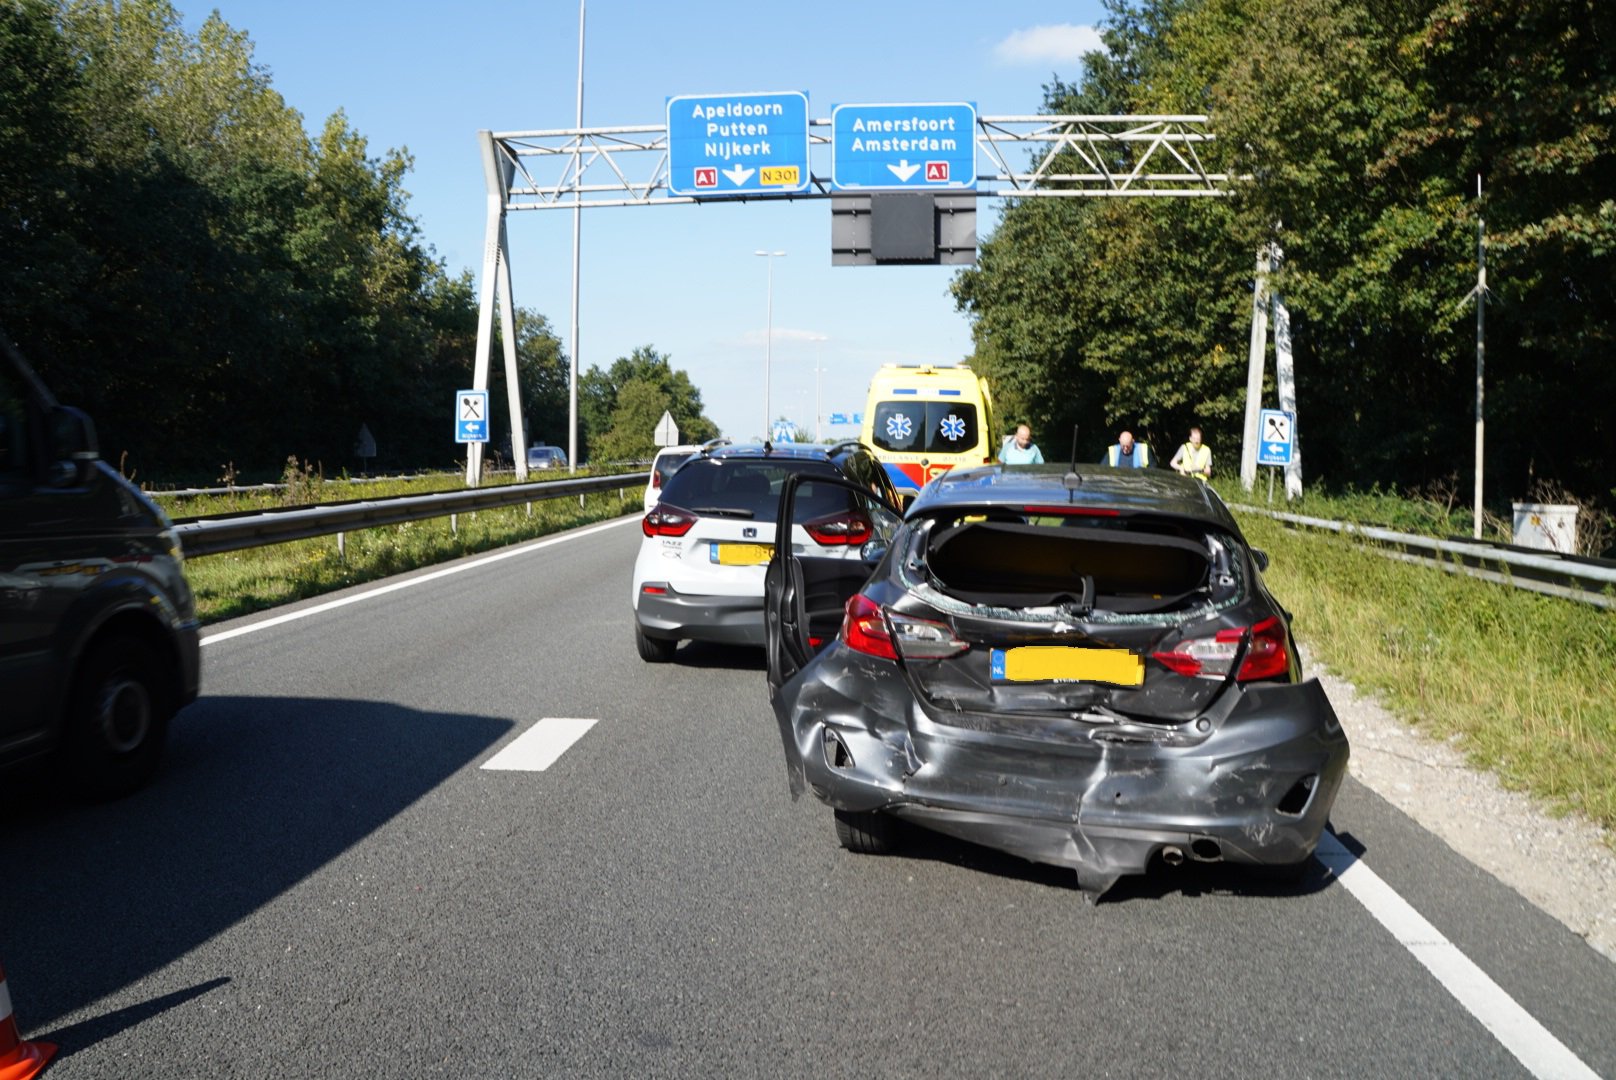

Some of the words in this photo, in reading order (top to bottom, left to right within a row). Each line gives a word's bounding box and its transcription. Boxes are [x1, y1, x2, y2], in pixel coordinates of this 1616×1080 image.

[692, 102, 783, 119] Apeldoorn
[707, 122, 768, 138] Putten
[853, 116, 955, 132] Amersfoort
[705, 140, 771, 160] Nijkerk
[852, 136, 957, 152] Amsterdam
[697, 171, 715, 184] A1
[929, 165, 946, 178] A1
[993, 666, 1004, 675] NL
